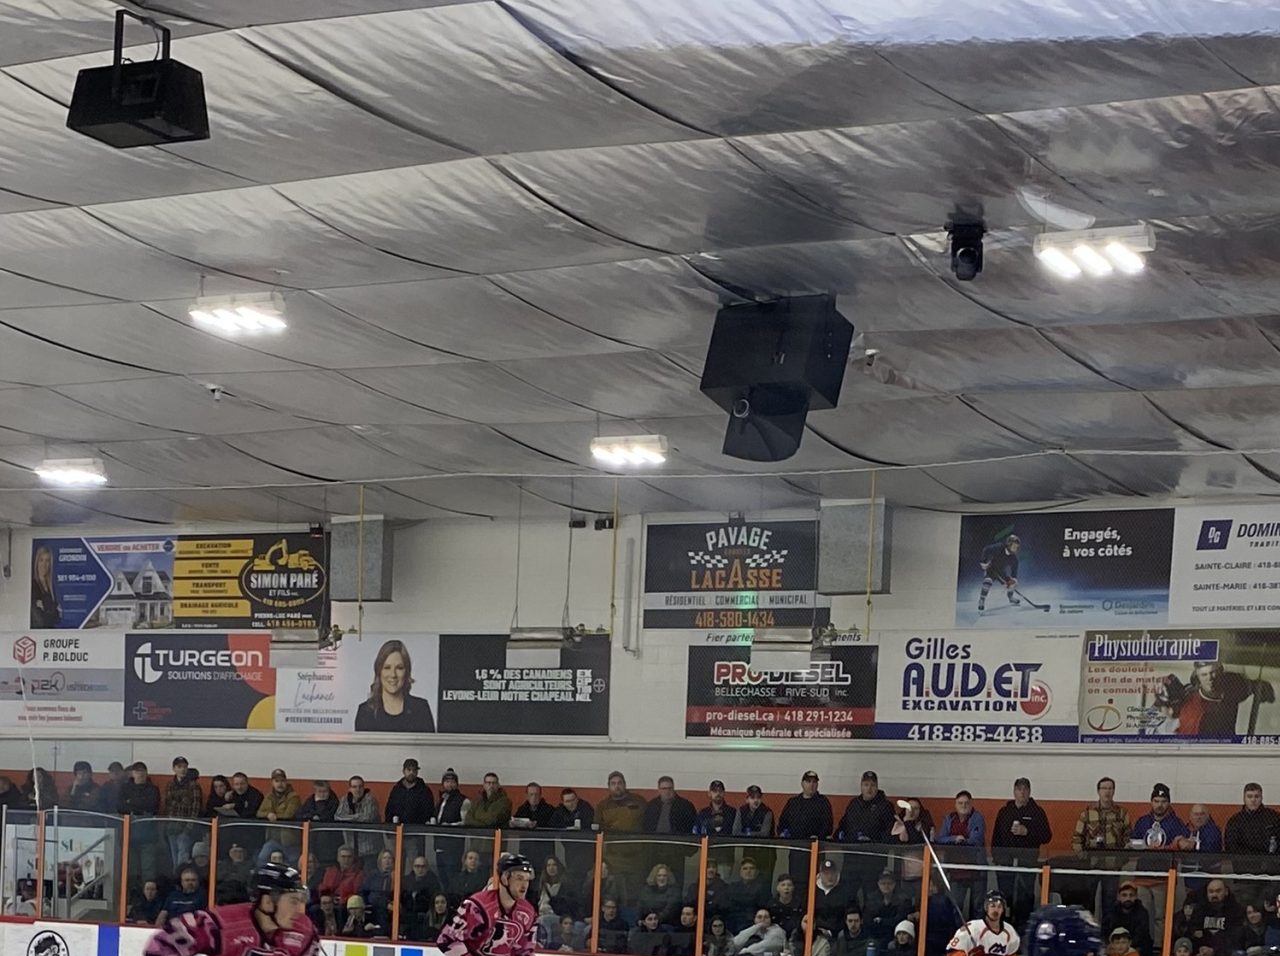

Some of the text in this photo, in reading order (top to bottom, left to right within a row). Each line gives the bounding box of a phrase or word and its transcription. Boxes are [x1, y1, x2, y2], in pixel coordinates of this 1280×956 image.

[705, 526, 772, 551] PAVAGE
[1064, 527, 1121, 543] Engagés,
[1062, 544, 1132, 558] à vos côtés
[1194, 561, 1252, 570] SAINTE-CLAIRE
[250, 569, 318, 588] SIMON PARÉ
[690, 558, 783, 588] LACASSE
[1193, 582, 1248, 591] SAINTE-MARIE
[665, 594, 808, 606] RÉSIDENTIEL COMMERCIAL MUNICIPAL
[695, 612, 775, 628] 418-580-1434
[43, 639, 80, 648] GROUPE
[706, 633, 755, 644] Fier parte
[905, 637, 971, 660] Gilles
[1094, 633, 1201, 660] Physiothérapie
[43, 652, 88, 661] P. BOLDUC
[155, 650, 263, 667] TURGEON
[168, 671, 211, 680] SOLUTIONS
[475, 669, 488, 680] 1,6
[504, 670, 521, 678] DES
[523, 670, 572, 679] CANADIENS
[483, 680, 507, 689] SONT
[443, 691, 499, 700] LEVONS-LEUR
[501, 691, 529, 700] NOTRE
[715, 687, 776, 696] BELLECHASSE
[786, 687, 829, 696] RIVE-SUD
[1031, 695, 1047, 703] inc.
[902, 700, 1017, 711] EXCAVATION
[706, 710, 853, 722] pro-diesel.ca 418 291-1234
[710, 726, 851, 737] Mécanique générale et spécialisée
[908, 725, 1043, 742] 418-885-4438
